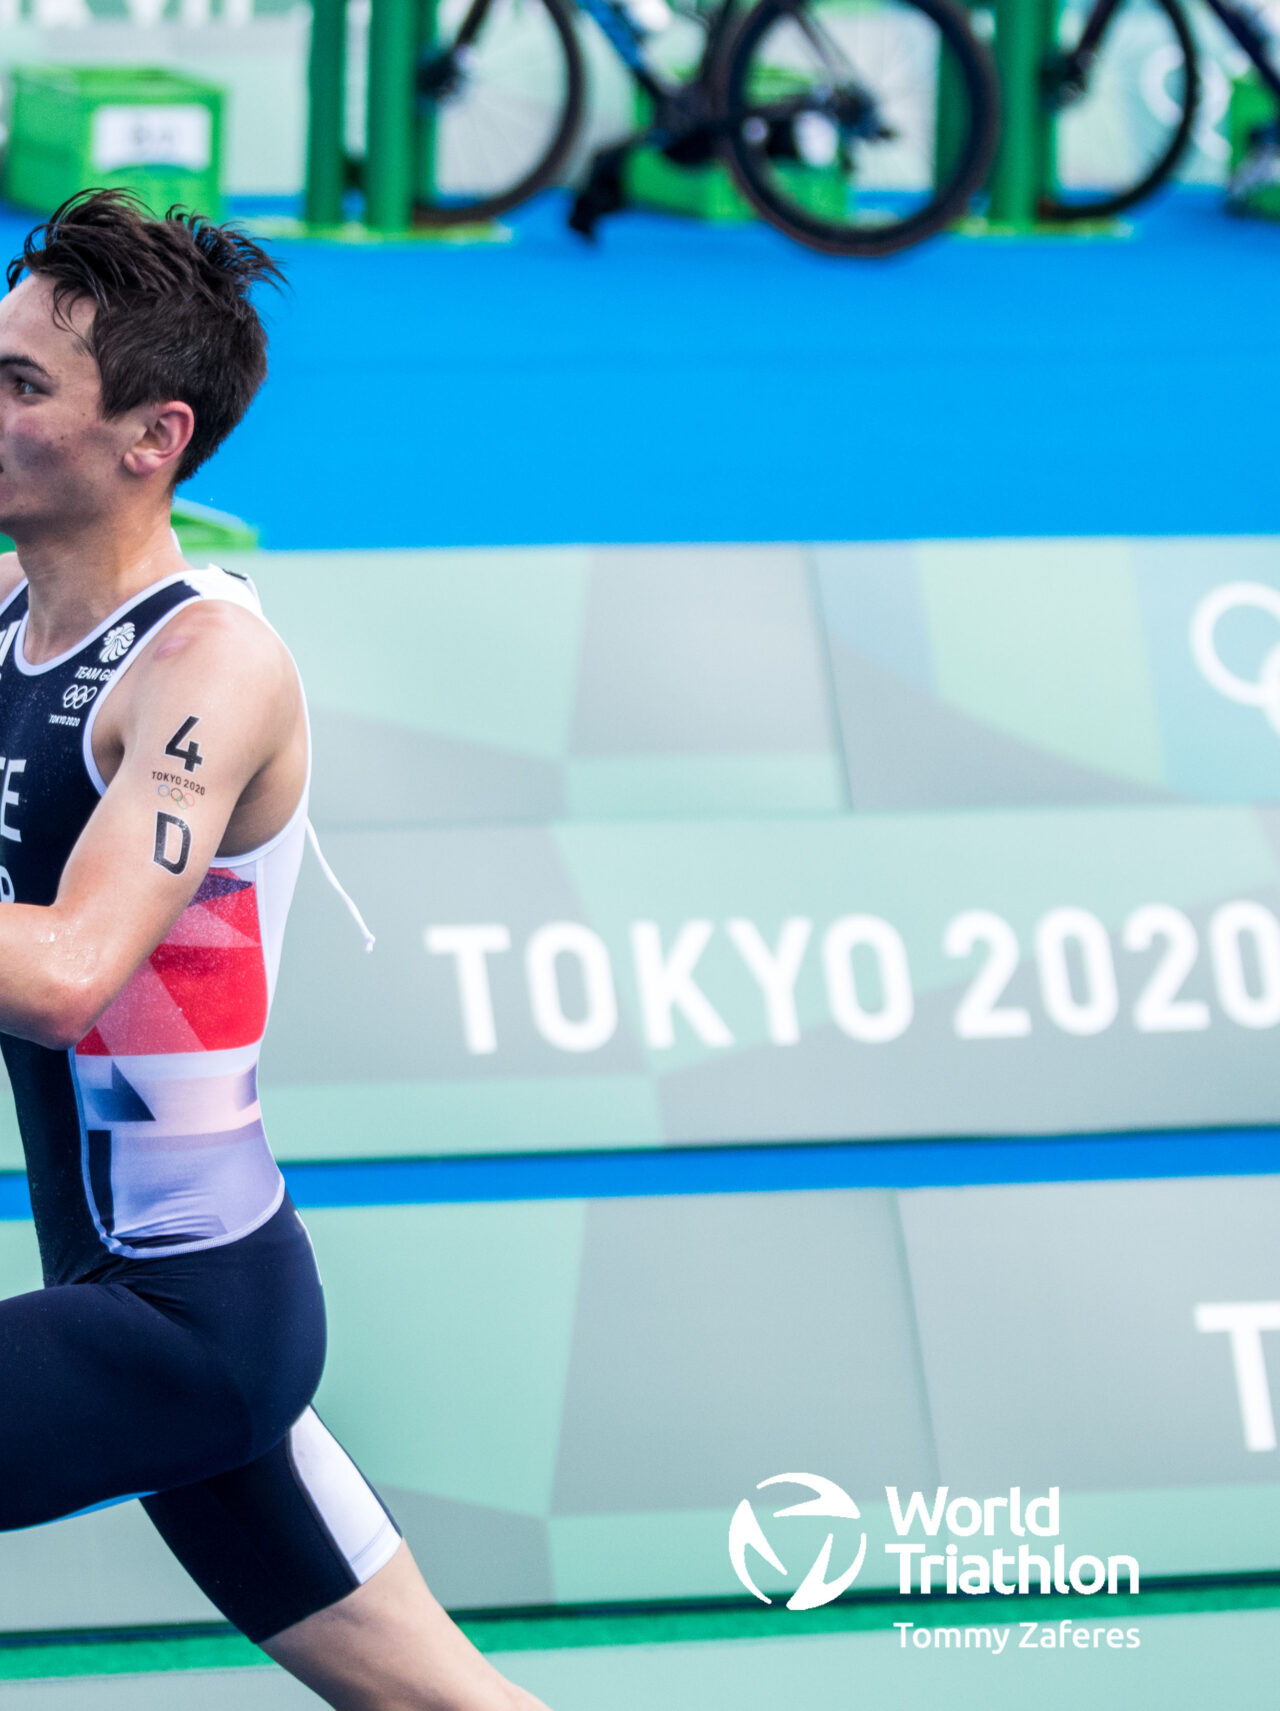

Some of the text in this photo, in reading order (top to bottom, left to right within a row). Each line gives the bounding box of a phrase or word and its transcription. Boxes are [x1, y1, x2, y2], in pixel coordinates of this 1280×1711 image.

[75, 666, 102, 680] TEAM
[48, 713, 81, 727] TOKYO 2020
[165, 715, 203, 773] 4
[152, 771, 206, 796] TOKYO 2020
[153, 811, 192, 875] D
[425, 901, 1280, 1053] TOKYO 2020
[1194, 1301, 1280, 1452] T
